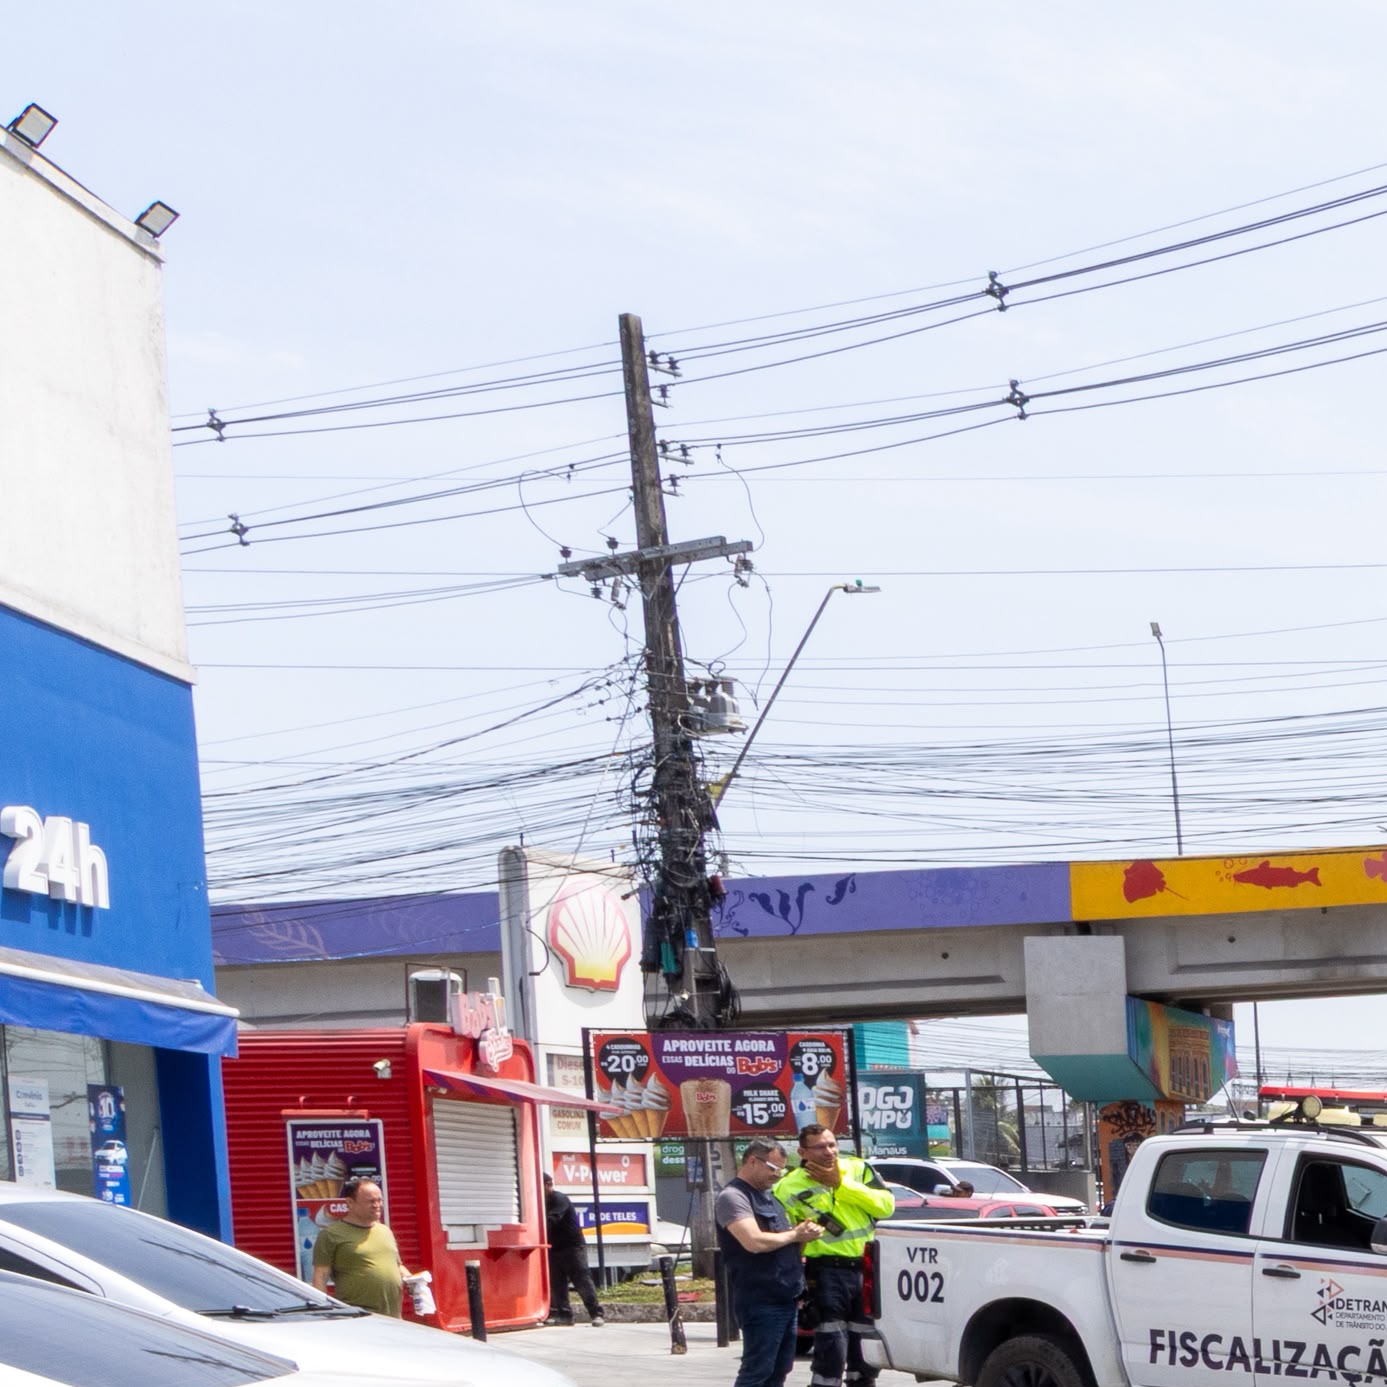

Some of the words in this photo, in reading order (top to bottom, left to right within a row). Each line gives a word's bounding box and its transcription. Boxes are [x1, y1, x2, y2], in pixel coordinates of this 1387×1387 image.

[0, 805, 110, 909] 24h
[663, 1040, 732, 1052] APROVEITE
[734, 1040, 775, 1052] AGORA
[684, 1054, 734, 1067] DELÍCIAS
[296, 1129, 341, 1139] APROVEITE
[343, 1129, 371, 1138] AGORA
[662, 1144, 685, 1155] drog
[868, 1145, 908, 1155] Manaus
[662, 1156, 685, 1164] dess
[612, 1212, 637, 1221] TELES
[906, 1247, 939, 1265] VTR
[897, 1268, 945, 1303] 002
[1335, 1311, 1386, 1323] DEPARTAMENTO
[1335, 1320, 1346, 1328] DE
[1345, 1320, 1375, 1330] TRÂNSITO
[1375, 1322, 1386, 1331] DO
